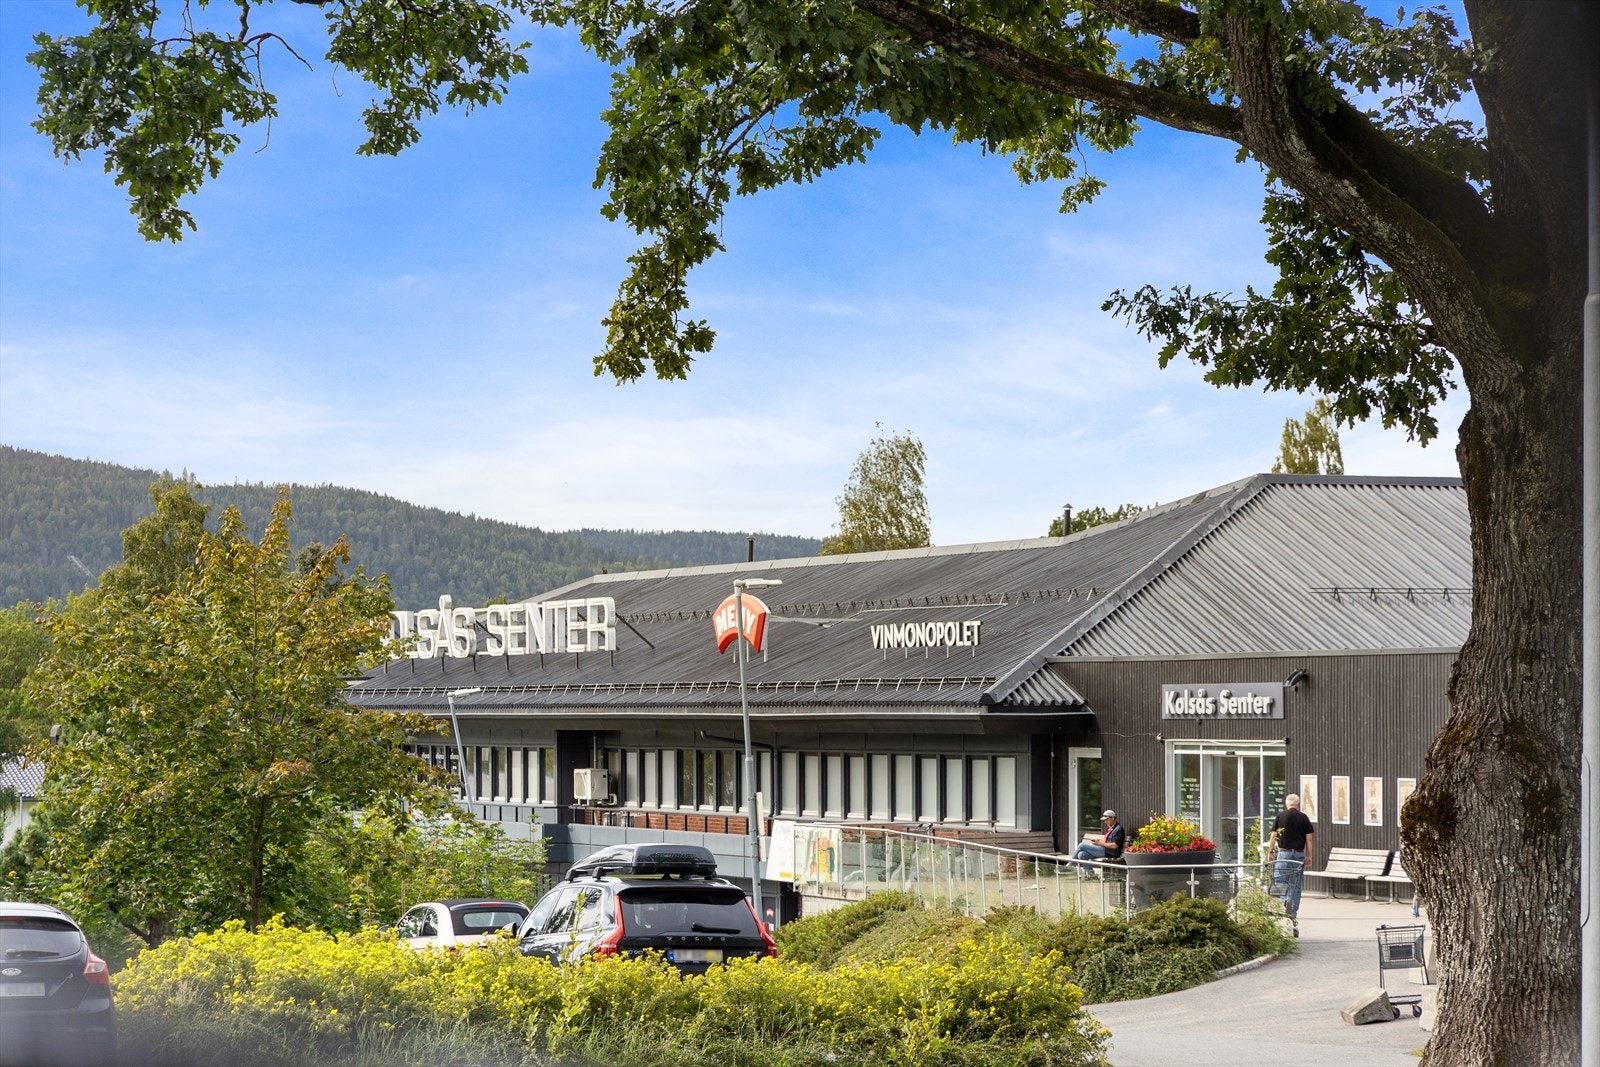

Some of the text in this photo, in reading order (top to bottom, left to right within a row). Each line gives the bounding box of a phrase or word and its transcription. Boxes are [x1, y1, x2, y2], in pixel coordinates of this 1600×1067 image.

[486, 597, 616, 656] SENTER
[870, 621, 982, 649] VINMONOPOLET
[1165, 688, 1272, 716] Kolsås Senter
